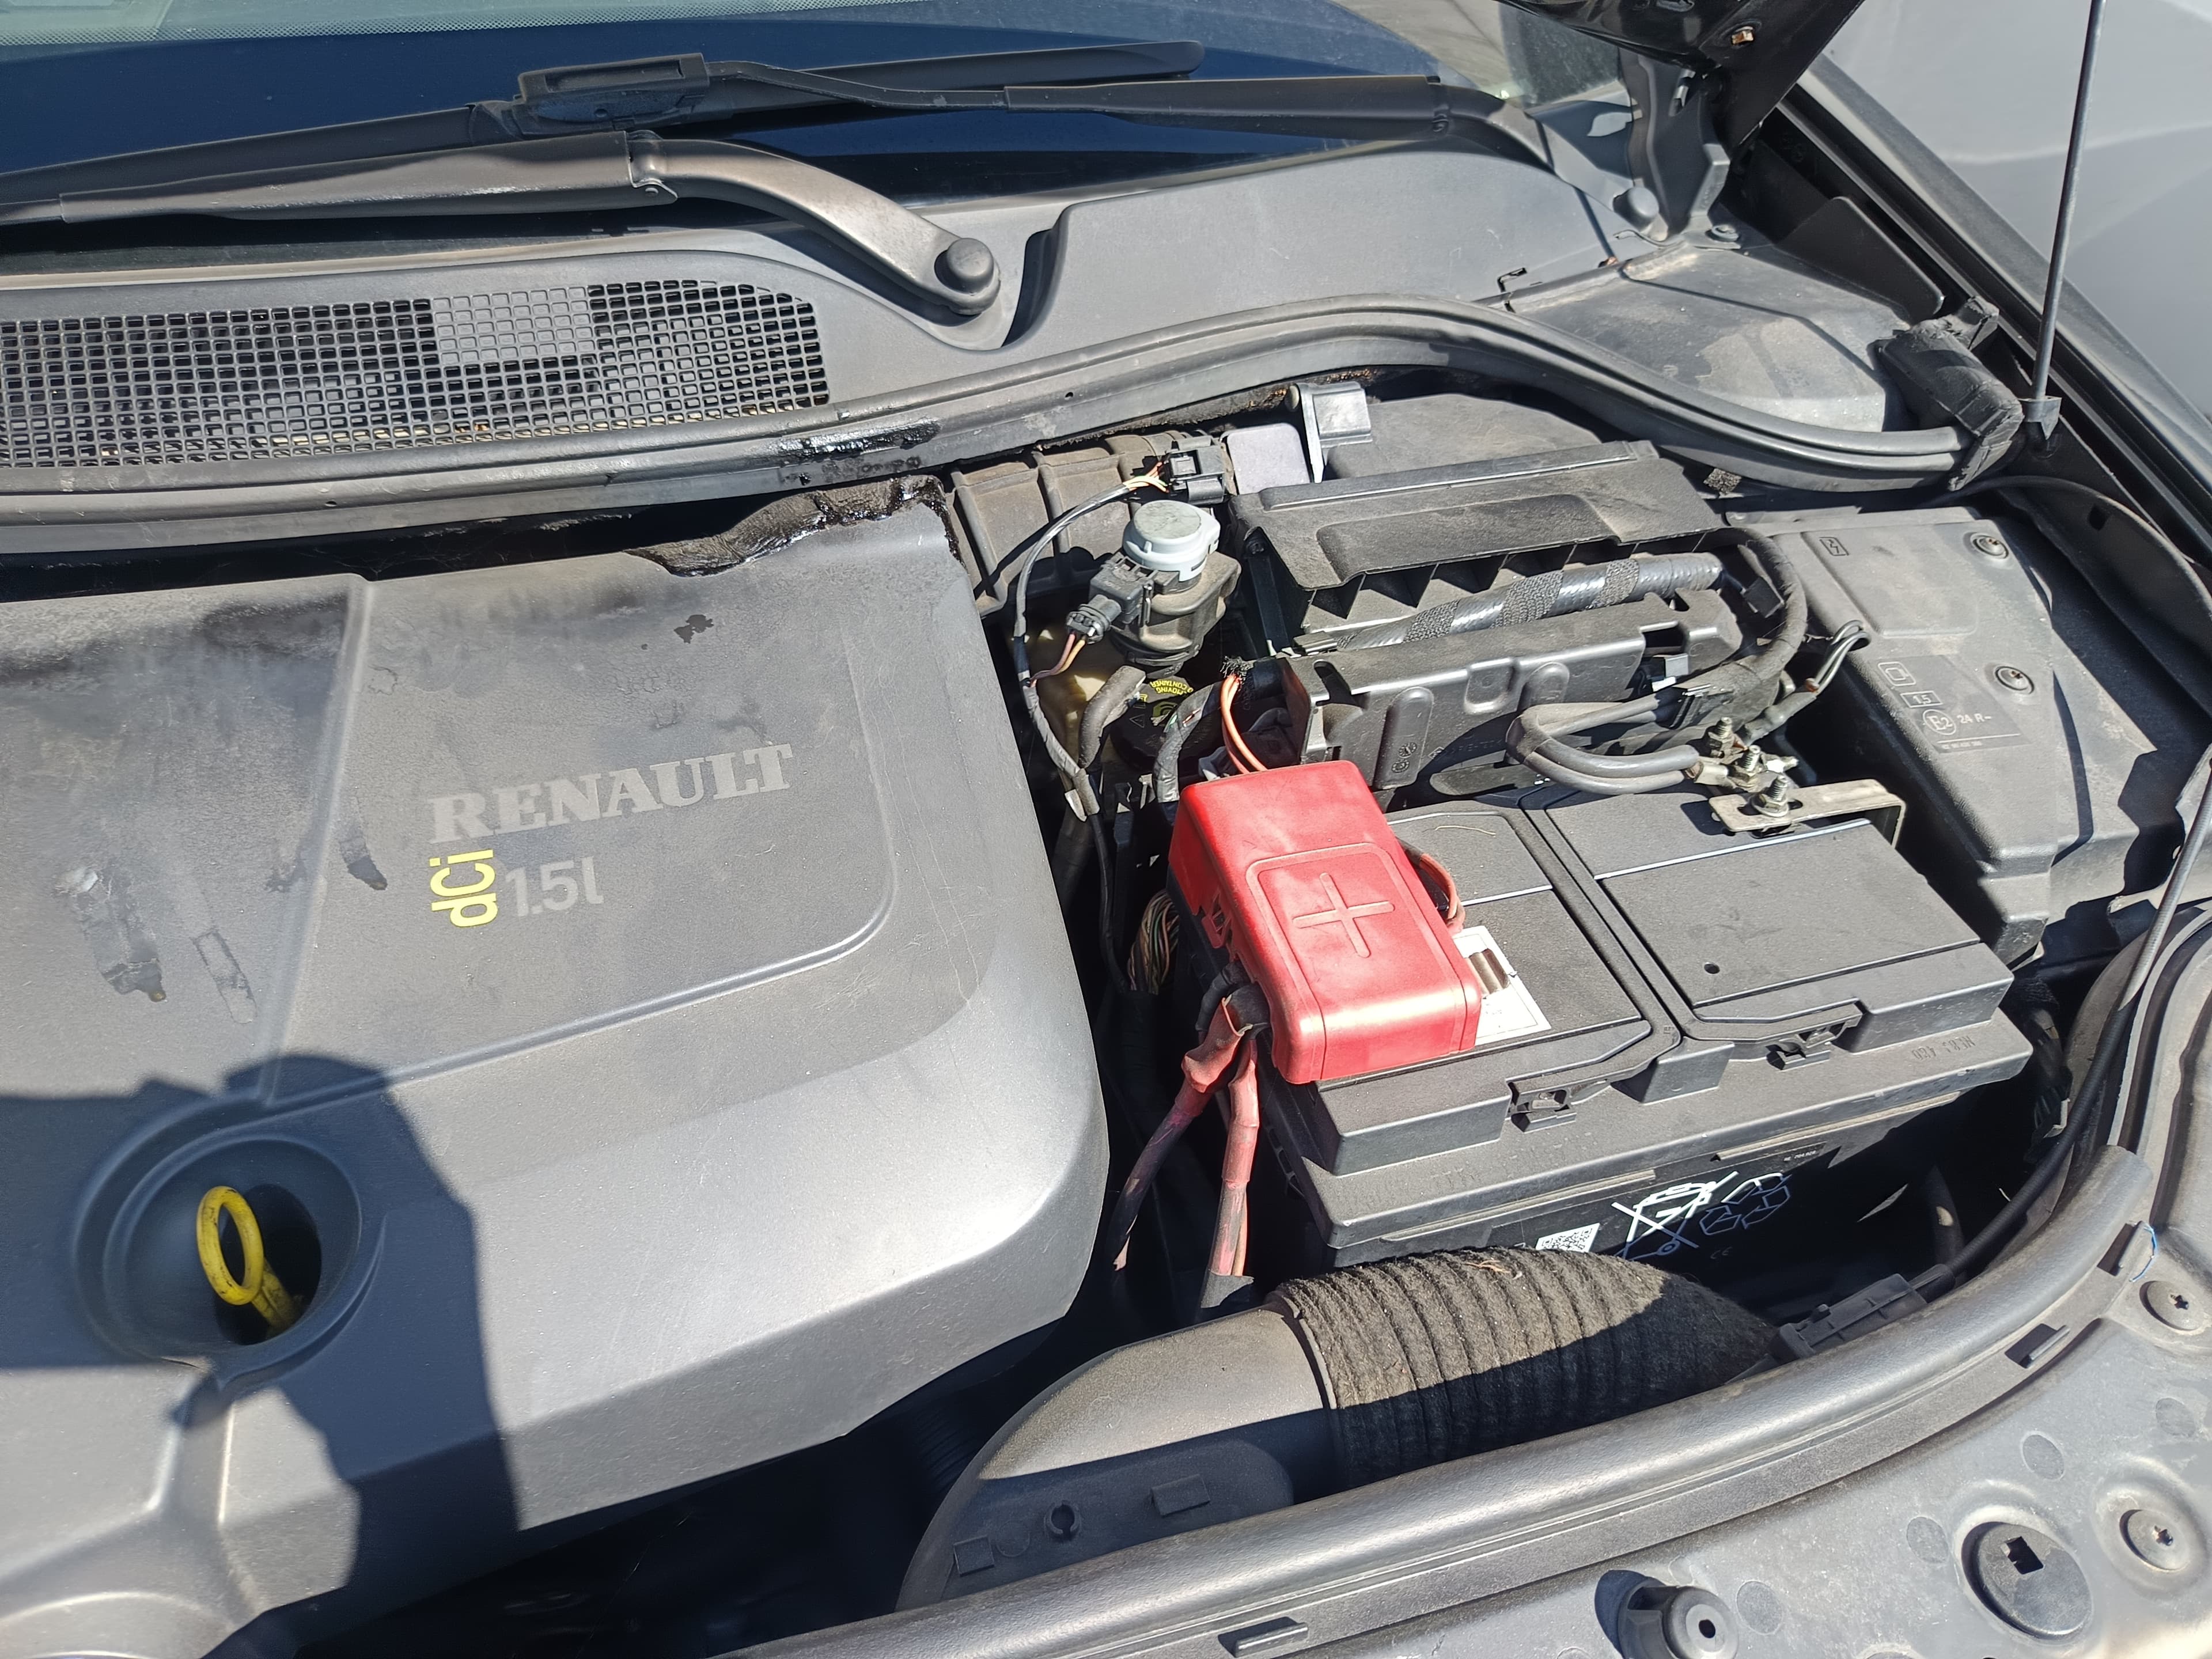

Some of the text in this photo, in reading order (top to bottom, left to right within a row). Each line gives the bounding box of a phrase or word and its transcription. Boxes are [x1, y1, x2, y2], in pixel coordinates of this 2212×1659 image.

[1150, 680, 1188, 691] CONTAINER
[1156, 687, 1185, 695] MOVING
[1927, 715, 1953, 731] E2
[426, 744, 793, 844] RENAULT
[430, 849, 498, 927] dCi
